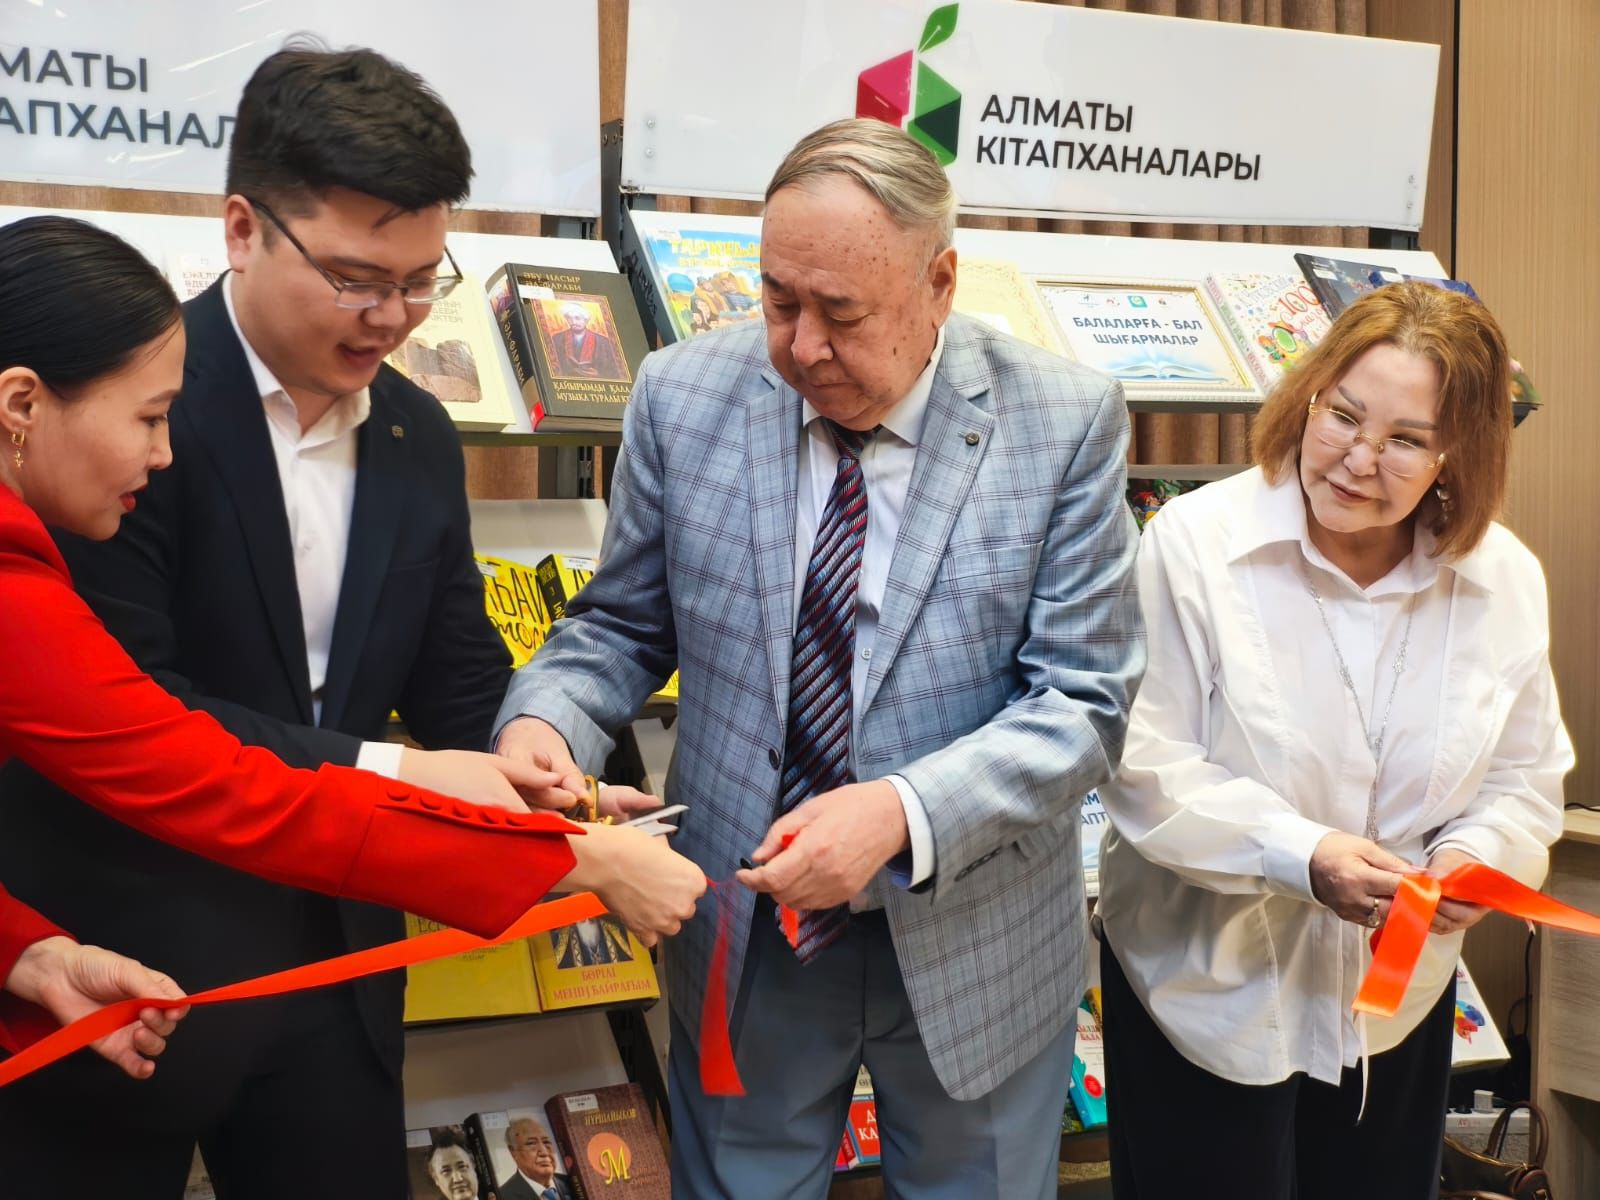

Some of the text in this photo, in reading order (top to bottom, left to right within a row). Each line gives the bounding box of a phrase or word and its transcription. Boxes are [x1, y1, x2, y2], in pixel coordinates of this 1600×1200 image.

[980, 94, 1134, 133] АЛМАТЫ
[976, 135, 1261, 181] КІТАПХАНАЛАРЫ
[1073, 317, 1161, 330] БАЛАЛАРҒА
[1172, 319, 1204, 331] БАЛ
[1093, 333, 1199, 347] ШЫҒАРМАЛАР
